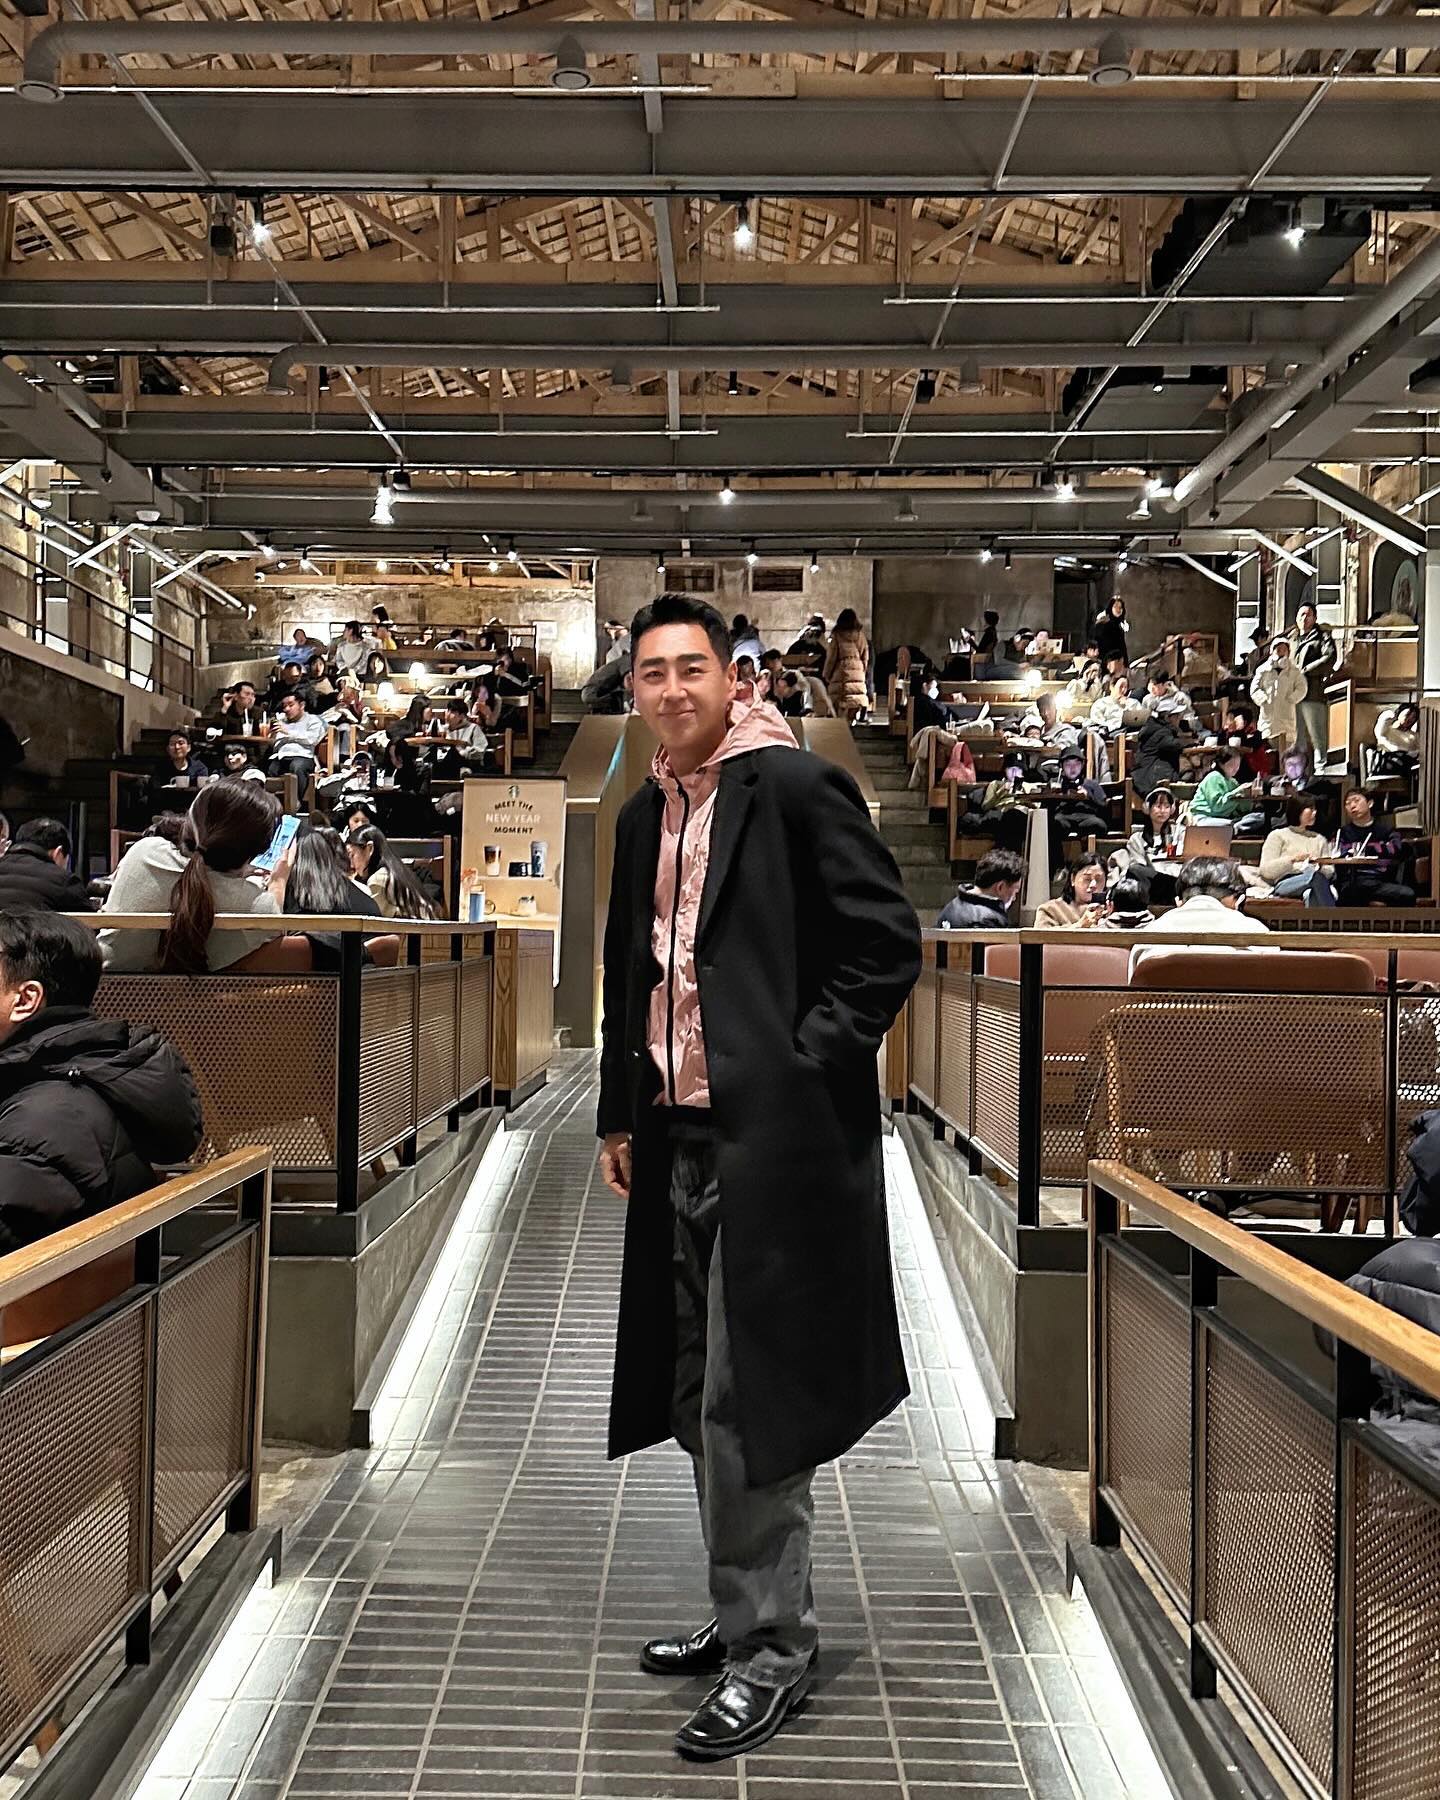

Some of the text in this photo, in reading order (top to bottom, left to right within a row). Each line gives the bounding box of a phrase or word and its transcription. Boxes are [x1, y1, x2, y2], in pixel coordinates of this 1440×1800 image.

[495, 800, 533, 811] MEET THE
[486, 813, 541, 824] NEW YEAR
[494, 826, 533, 834] MOMENT
